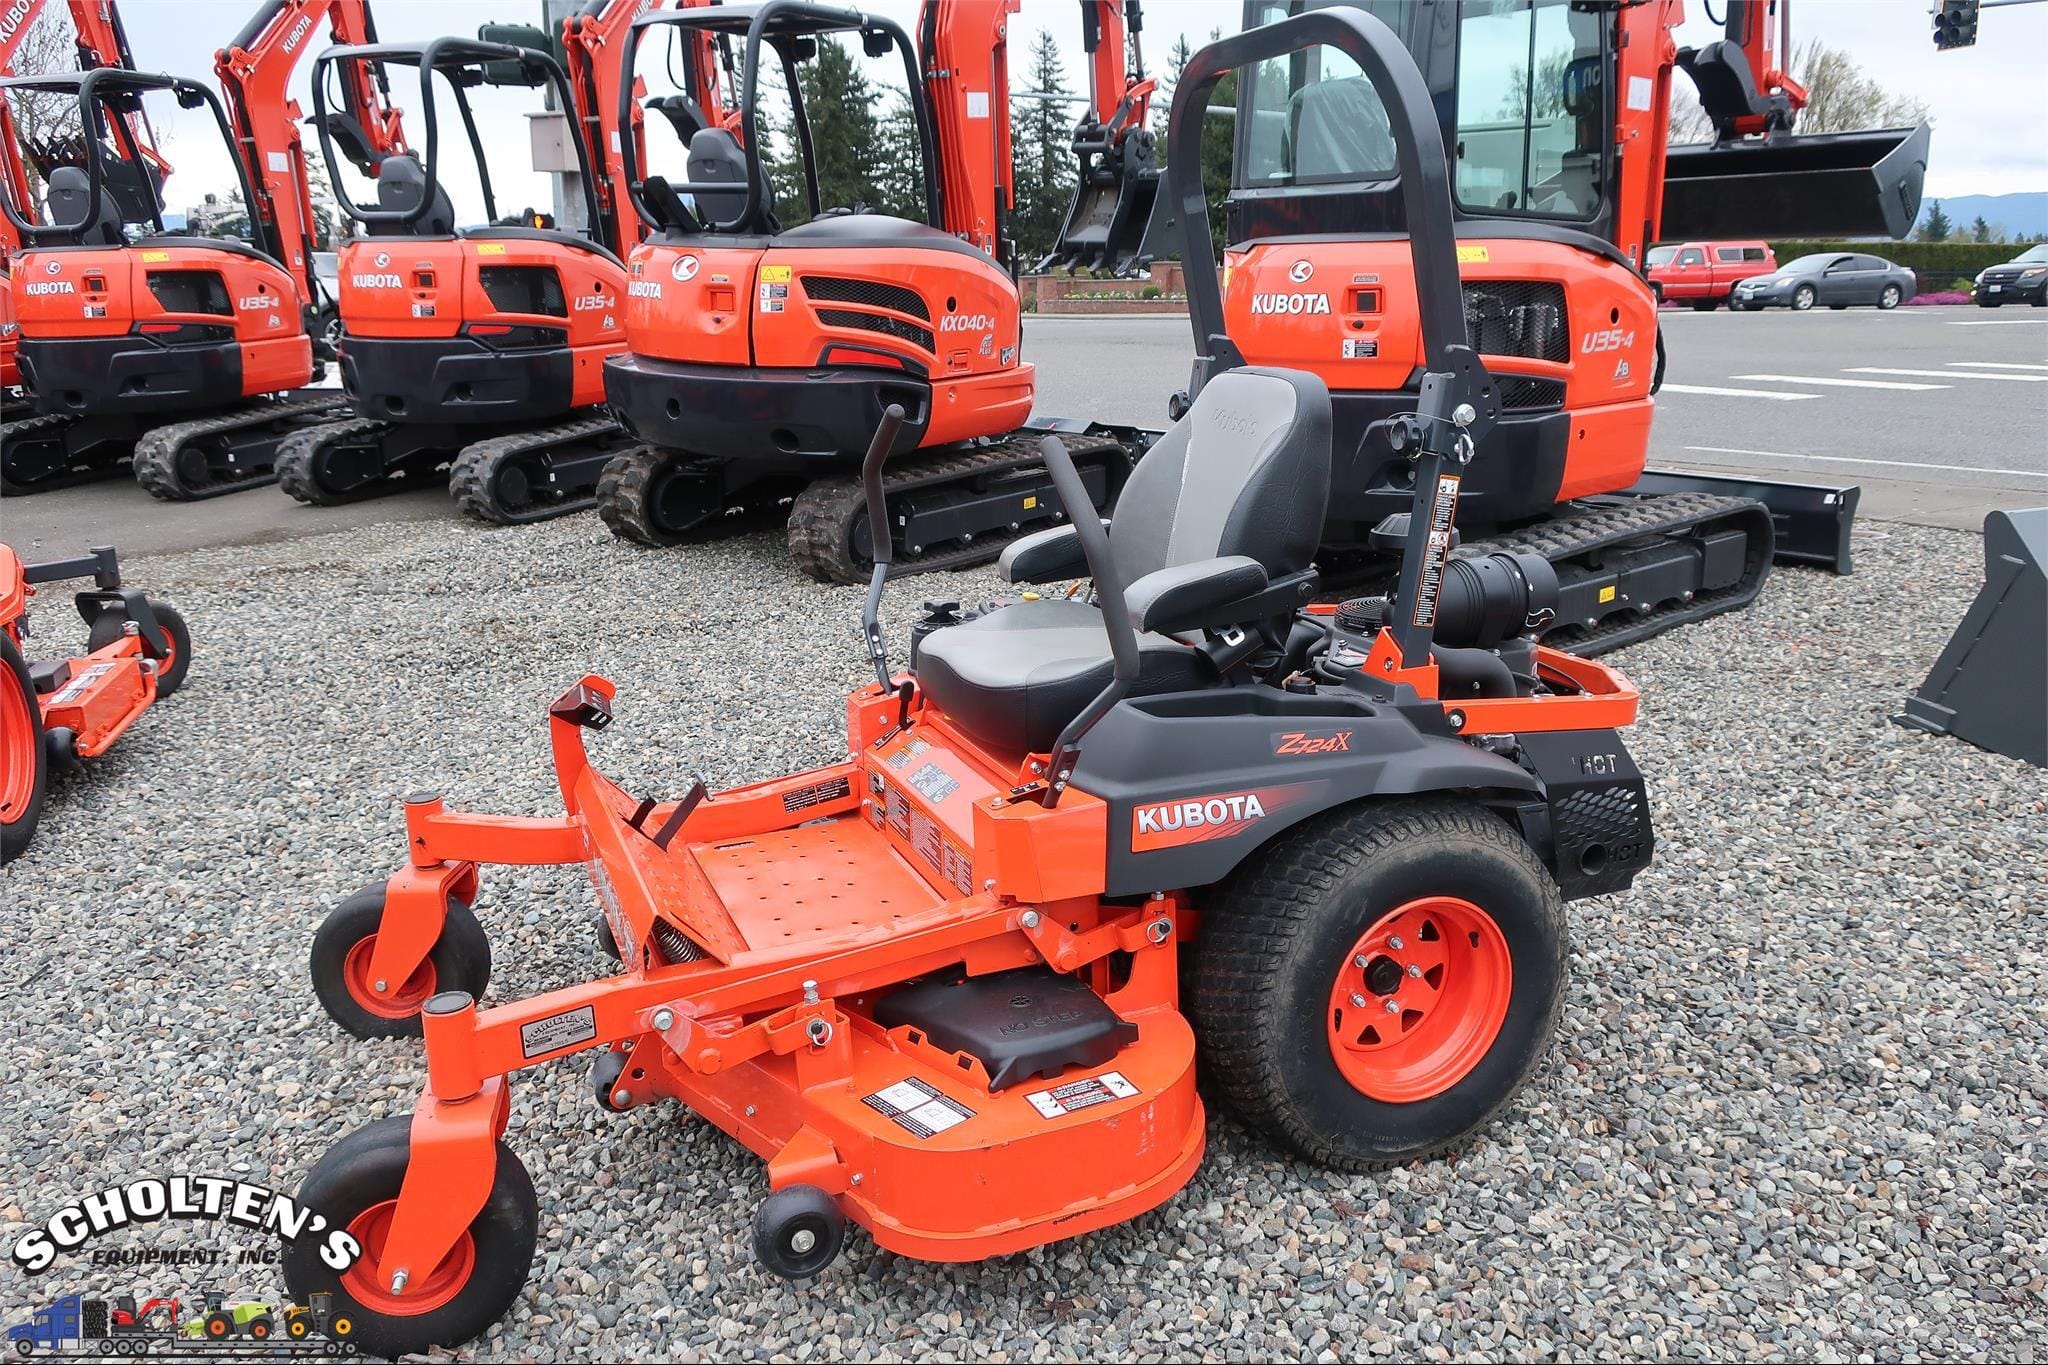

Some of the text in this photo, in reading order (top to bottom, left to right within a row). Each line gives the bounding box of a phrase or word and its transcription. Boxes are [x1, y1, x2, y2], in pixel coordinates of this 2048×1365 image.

[281, 14, 313, 55] KUBOTA
[26, 281, 75, 296] KUBOTA
[352, 273, 403, 289] KUBOTA
[627, 281, 662, 299] KUBOTA
[239, 296, 280, 310] U35-4
[574, 294, 615, 312] U35-4
[1251, 293, 1331, 315] KUBOTA
[940, 314, 995, 332] KX040-4
[1581, 328, 1635, 354] U35-4
[1275, 731, 1353, 756] Z724X
[1580, 754, 1617, 776] HOT
[1137, 794, 1266, 834] KUBOTA
